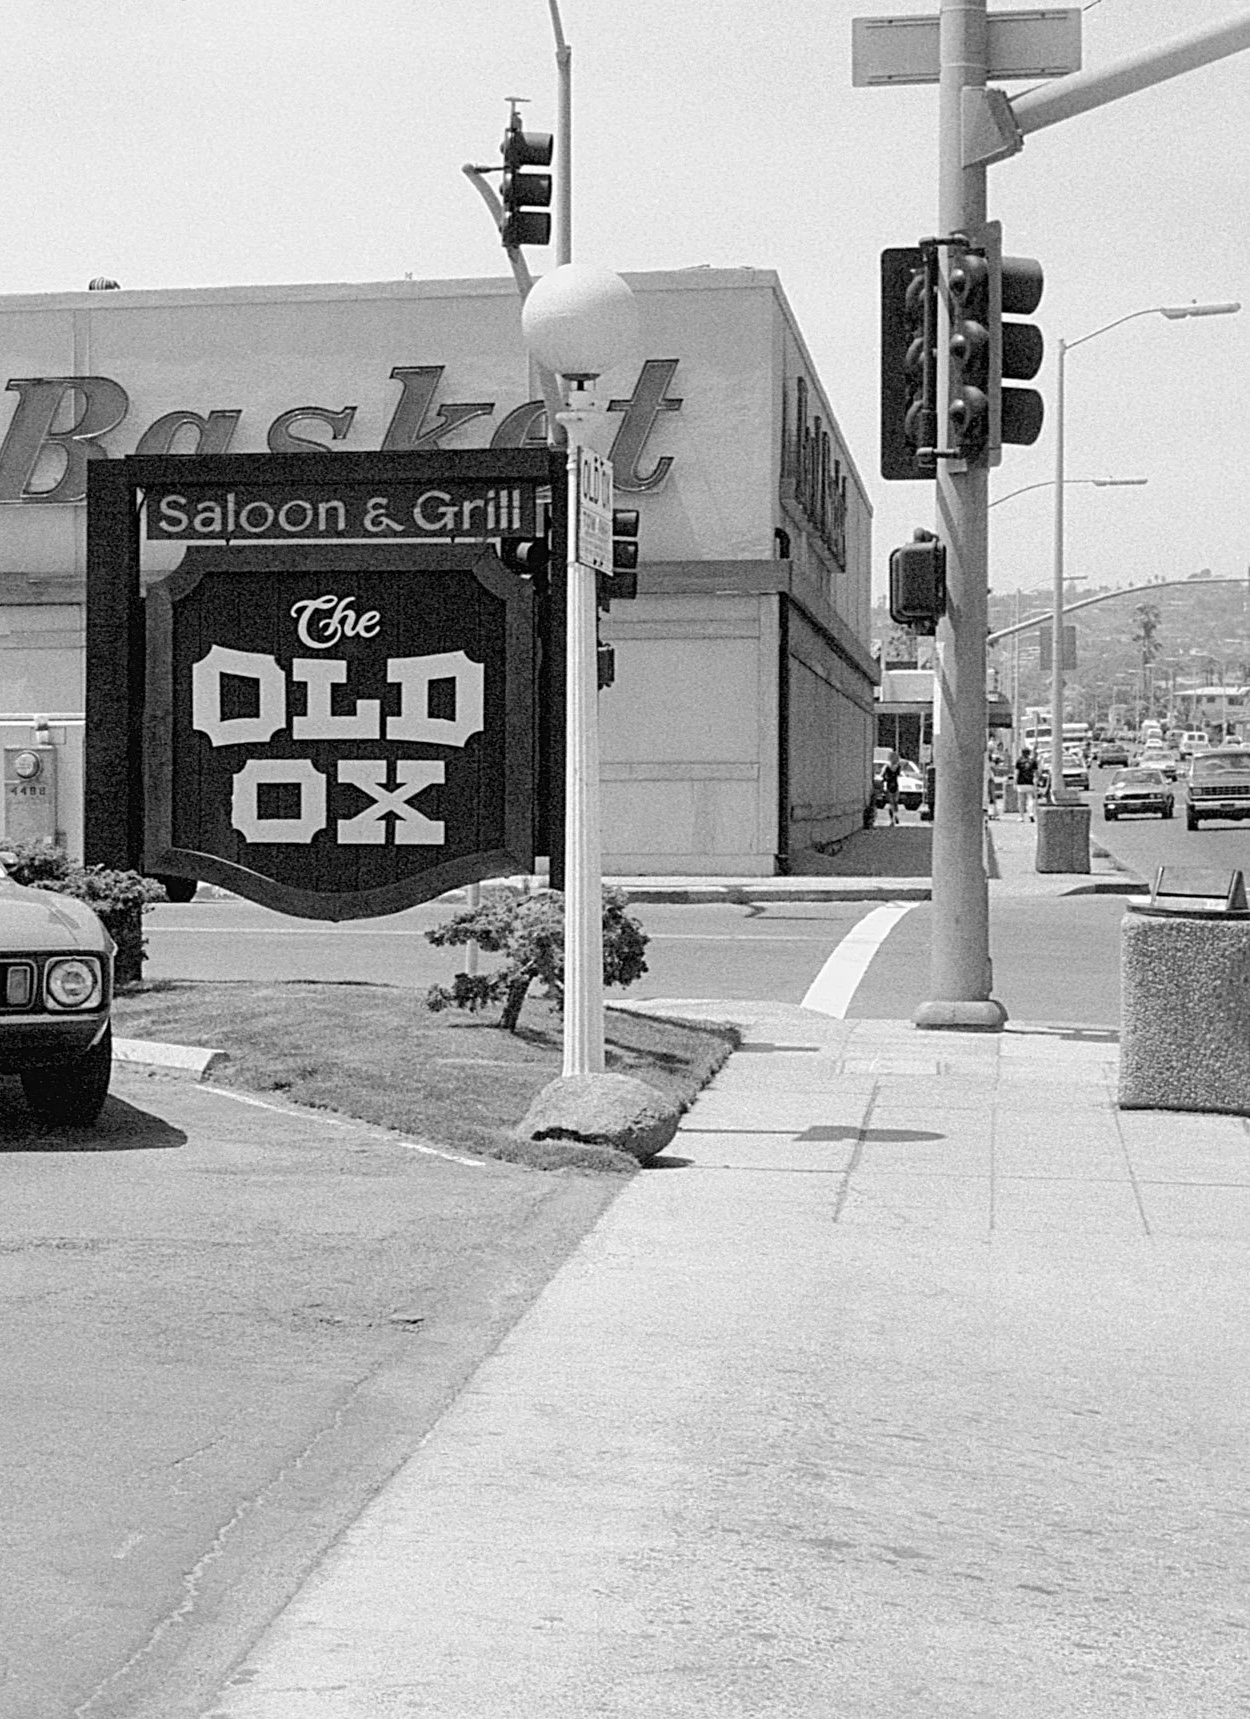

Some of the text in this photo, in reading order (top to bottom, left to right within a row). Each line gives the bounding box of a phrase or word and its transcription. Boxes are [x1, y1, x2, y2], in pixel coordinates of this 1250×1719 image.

[158, 489, 522, 534] Saloon & Grill
[289, 594, 382, 650] The
[191, 643, 486, 749] OLD
[230, 758, 447, 846] OX
